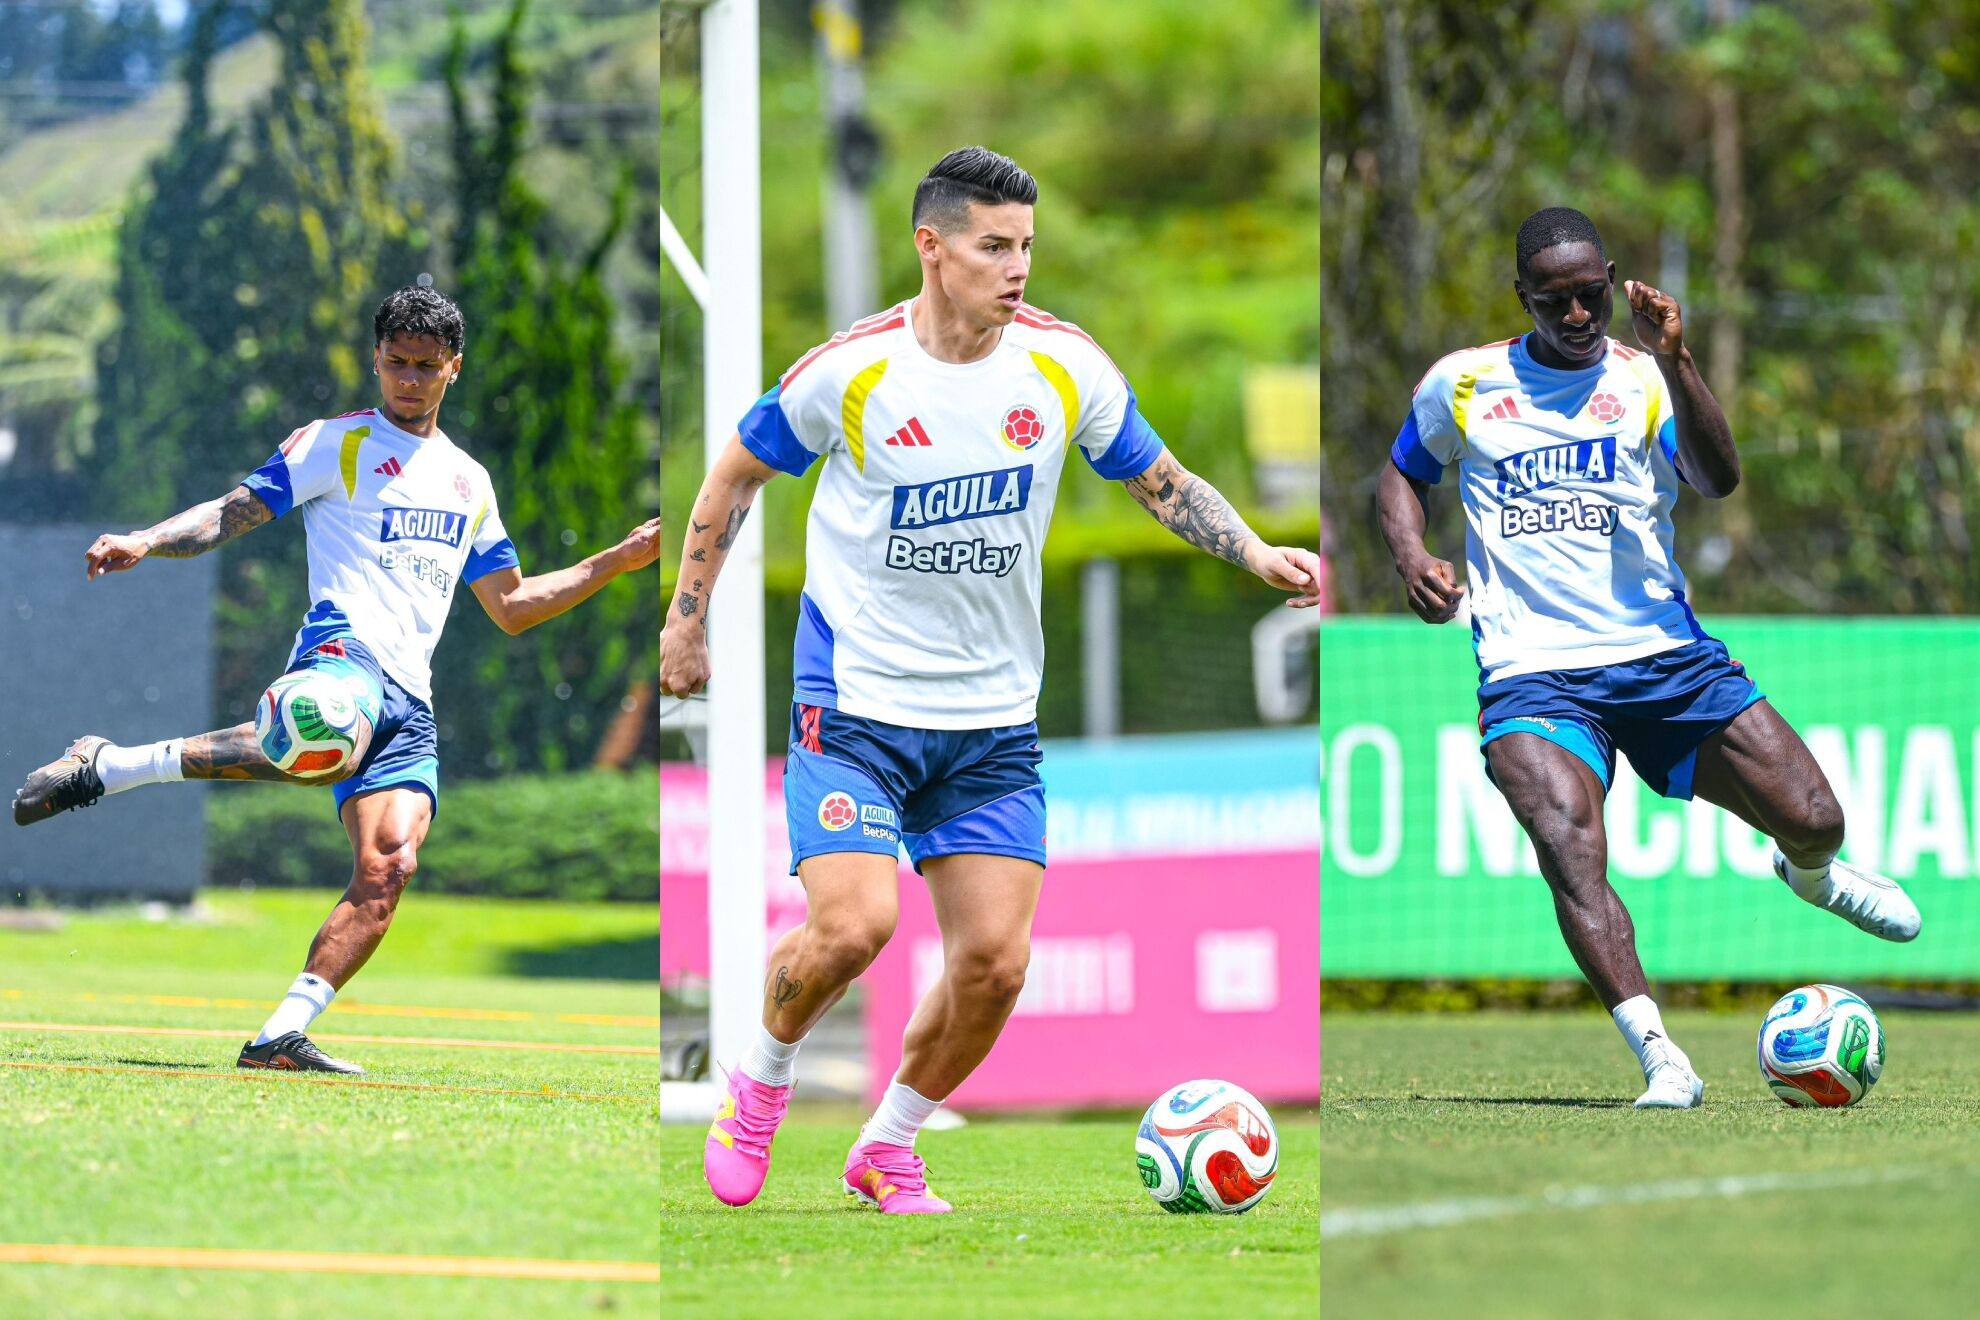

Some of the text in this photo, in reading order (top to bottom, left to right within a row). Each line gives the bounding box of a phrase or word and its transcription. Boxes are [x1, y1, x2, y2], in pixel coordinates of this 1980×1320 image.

[1503, 441, 1608, 499] AGUILA
[897, 470, 1021, 527] AGUILA
[1501, 497, 1619, 538] BetPlay
[386, 510, 462, 545] AGUILA
[379, 545, 454, 598] BetPlay
[886, 535, 1022, 578] BetPlay
[864, 807, 894, 824] AGUILA
[1320, 722, 1404, 878] O
[863, 825, 896, 843] BetPlay
